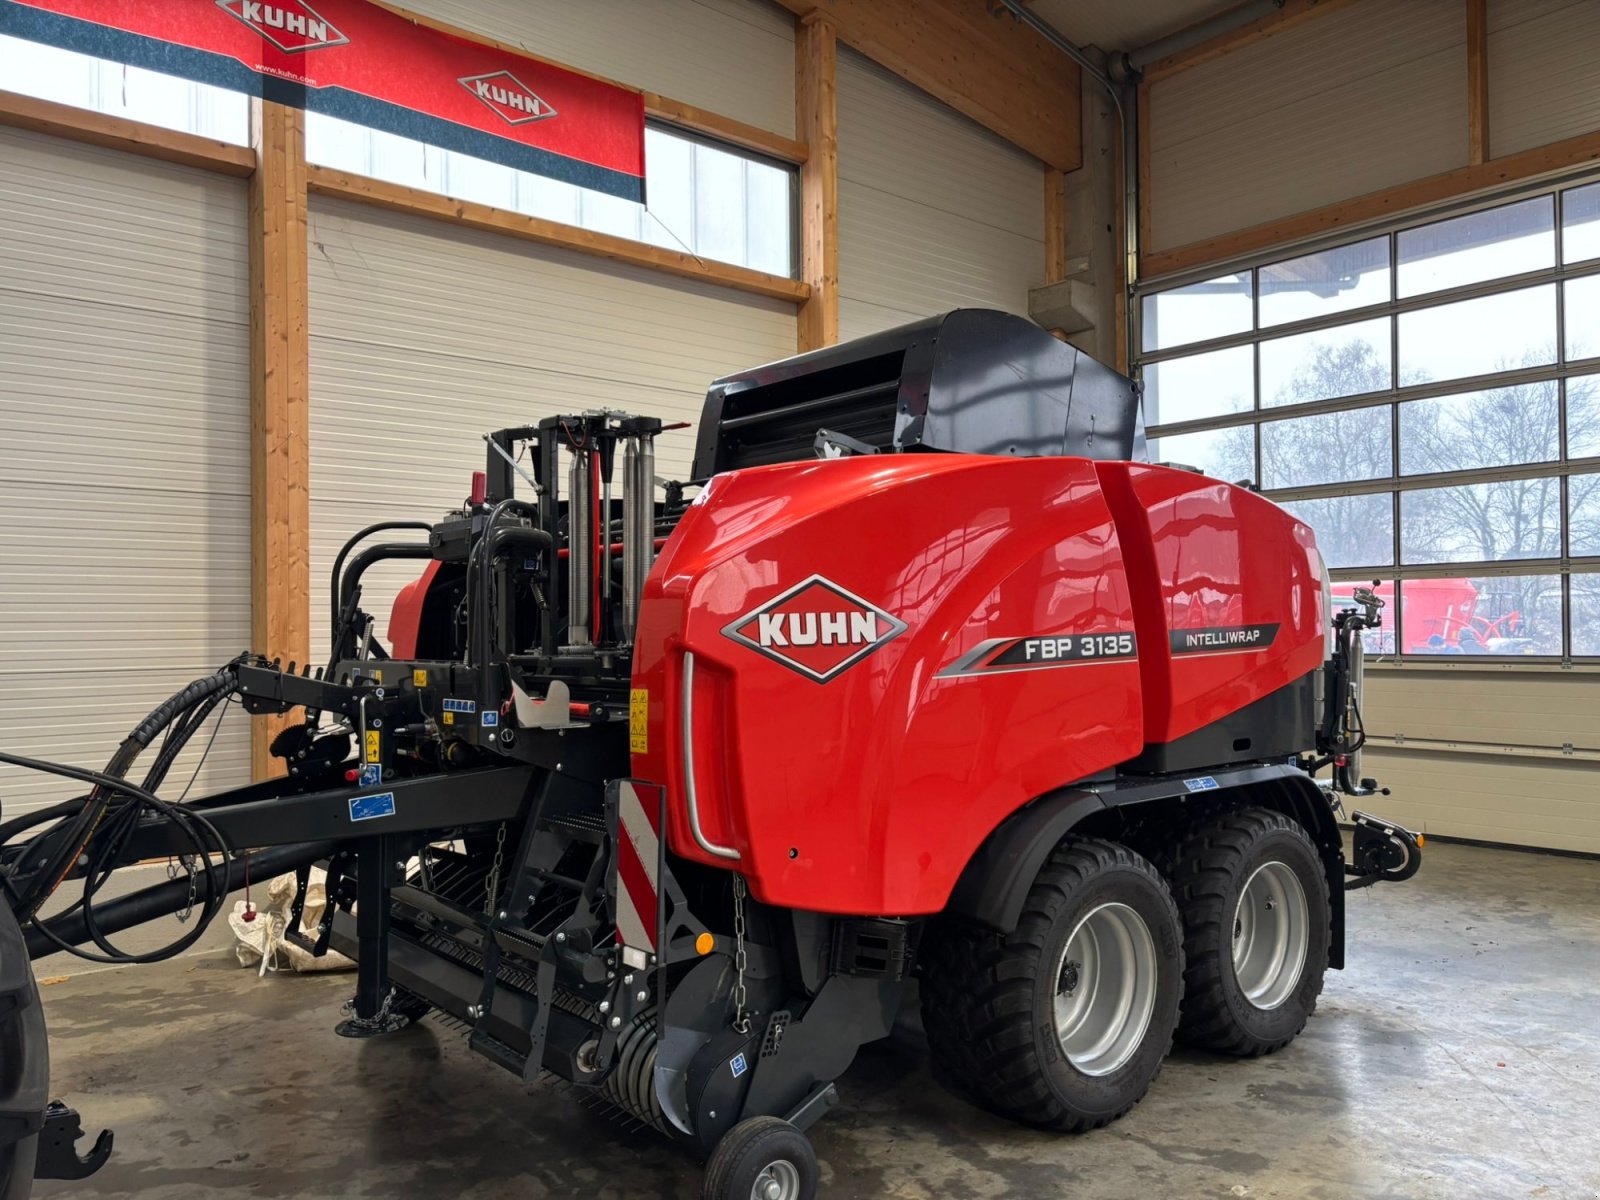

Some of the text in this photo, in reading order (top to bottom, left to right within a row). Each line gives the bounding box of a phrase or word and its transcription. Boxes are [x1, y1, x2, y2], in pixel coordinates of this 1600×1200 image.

[242, 0, 327, 42] KUHN
[255, 63, 317, 86] www.kuhn.com
[475, 79, 540, 116] KUHN
[758, 611, 877, 647] KUHN
[1186, 629, 1260, 647] INTELLIWRAP
[1025, 635, 1132, 660] FBP 3135
